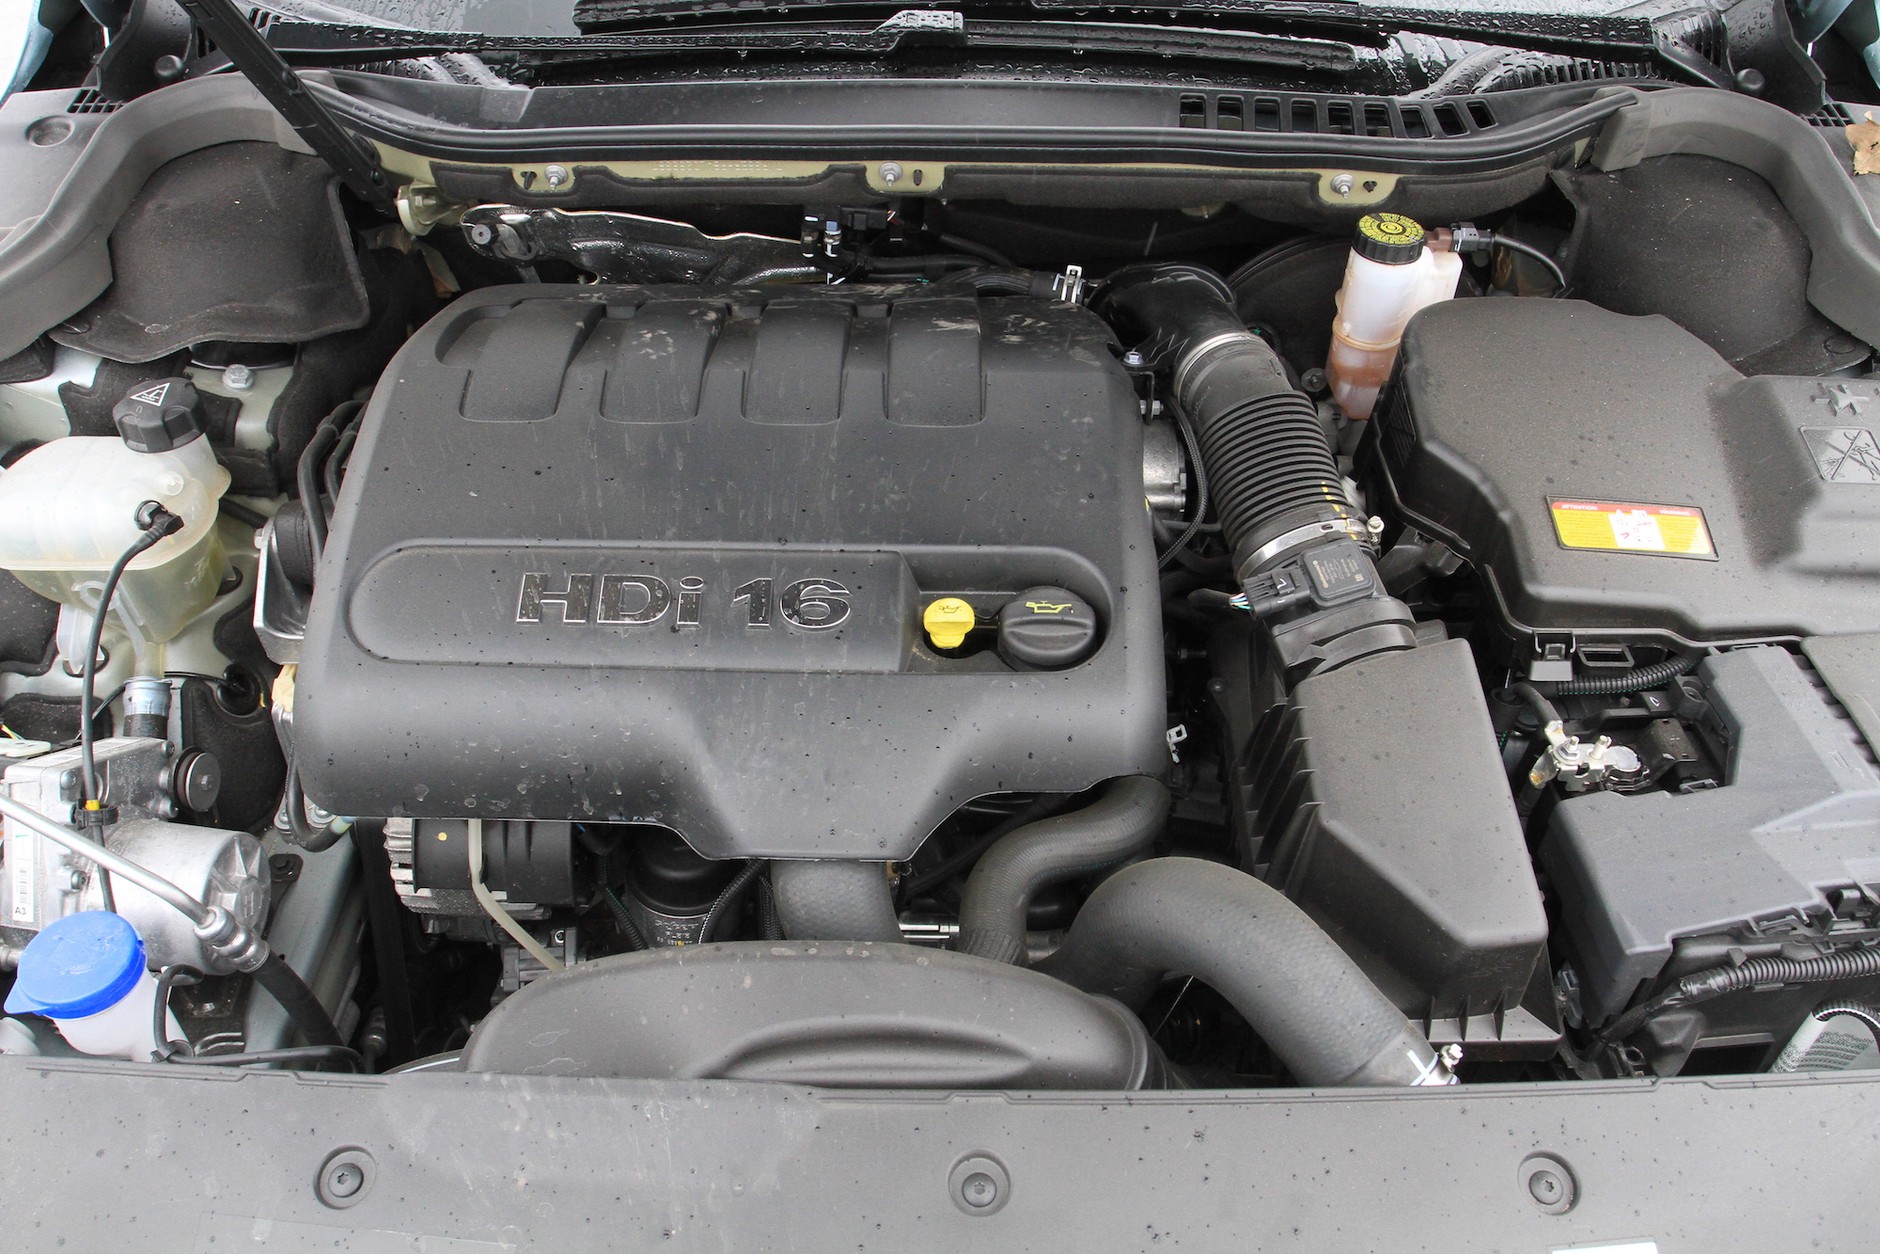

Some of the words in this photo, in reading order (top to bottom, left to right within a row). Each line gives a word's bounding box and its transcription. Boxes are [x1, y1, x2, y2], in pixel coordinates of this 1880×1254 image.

[515, 572, 705, 627] HDi
[732, 577, 852, 630] 16
[14, 906, 27, 916] A3
